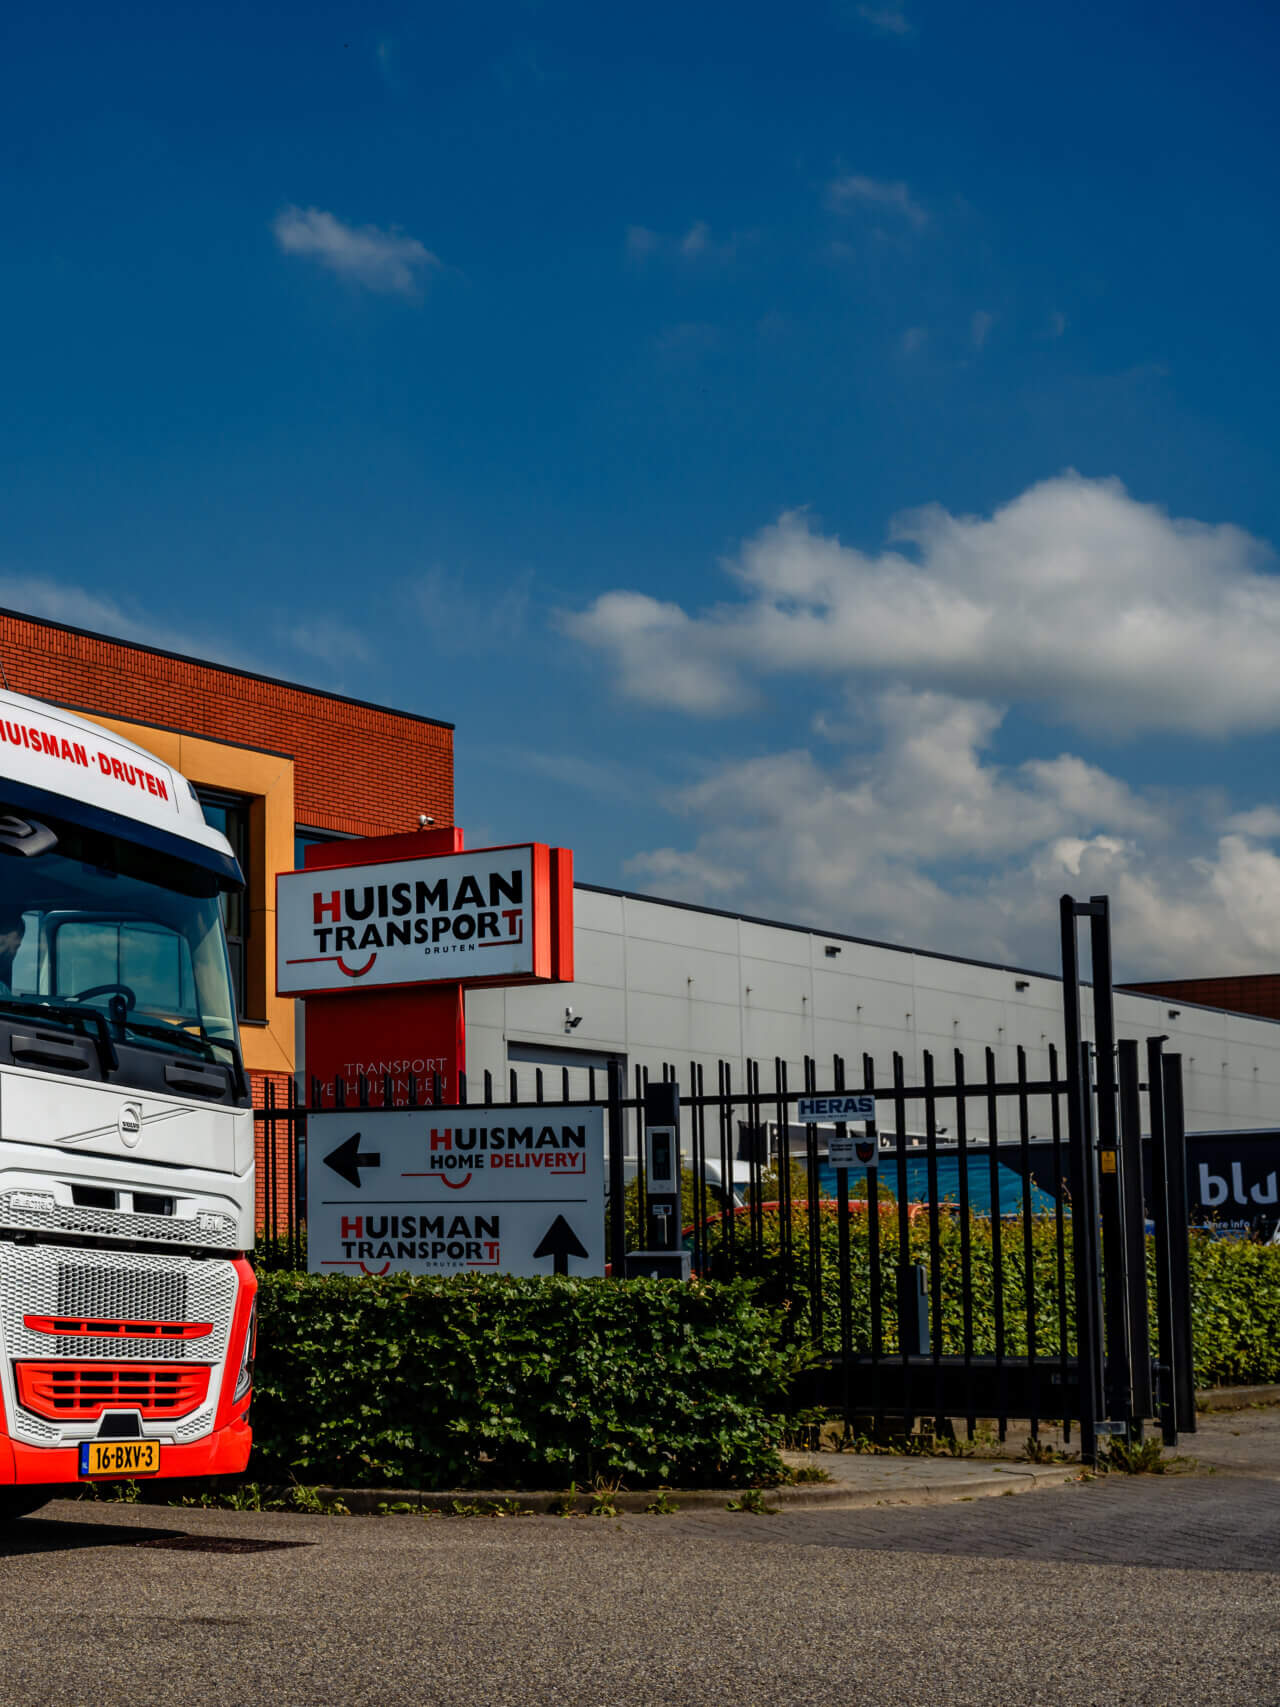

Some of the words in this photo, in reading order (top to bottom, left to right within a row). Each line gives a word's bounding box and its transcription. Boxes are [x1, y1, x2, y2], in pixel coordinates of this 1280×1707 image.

[97, 751, 169, 801] DRUTEN
[313, 869, 523, 925] HUISMAN
[313, 908, 523, 953] TRANSPORT
[424, 943, 475, 955] DRUTEN
[343, 1057, 448, 1077] TRANSPORT
[800, 1098, 873, 1115] HERAS
[430, 1125, 586, 1149] HUISMAN
[430, 1153, 484, 1169] HOME
[490, 1151, 580, 1169] DELIVERY
[341, 1215, 500, 1239] HUISMAN
[341, 1241, 500, 1260] TRANSPORT
[96, 1445, 153, 1470] 16-BXV-3
